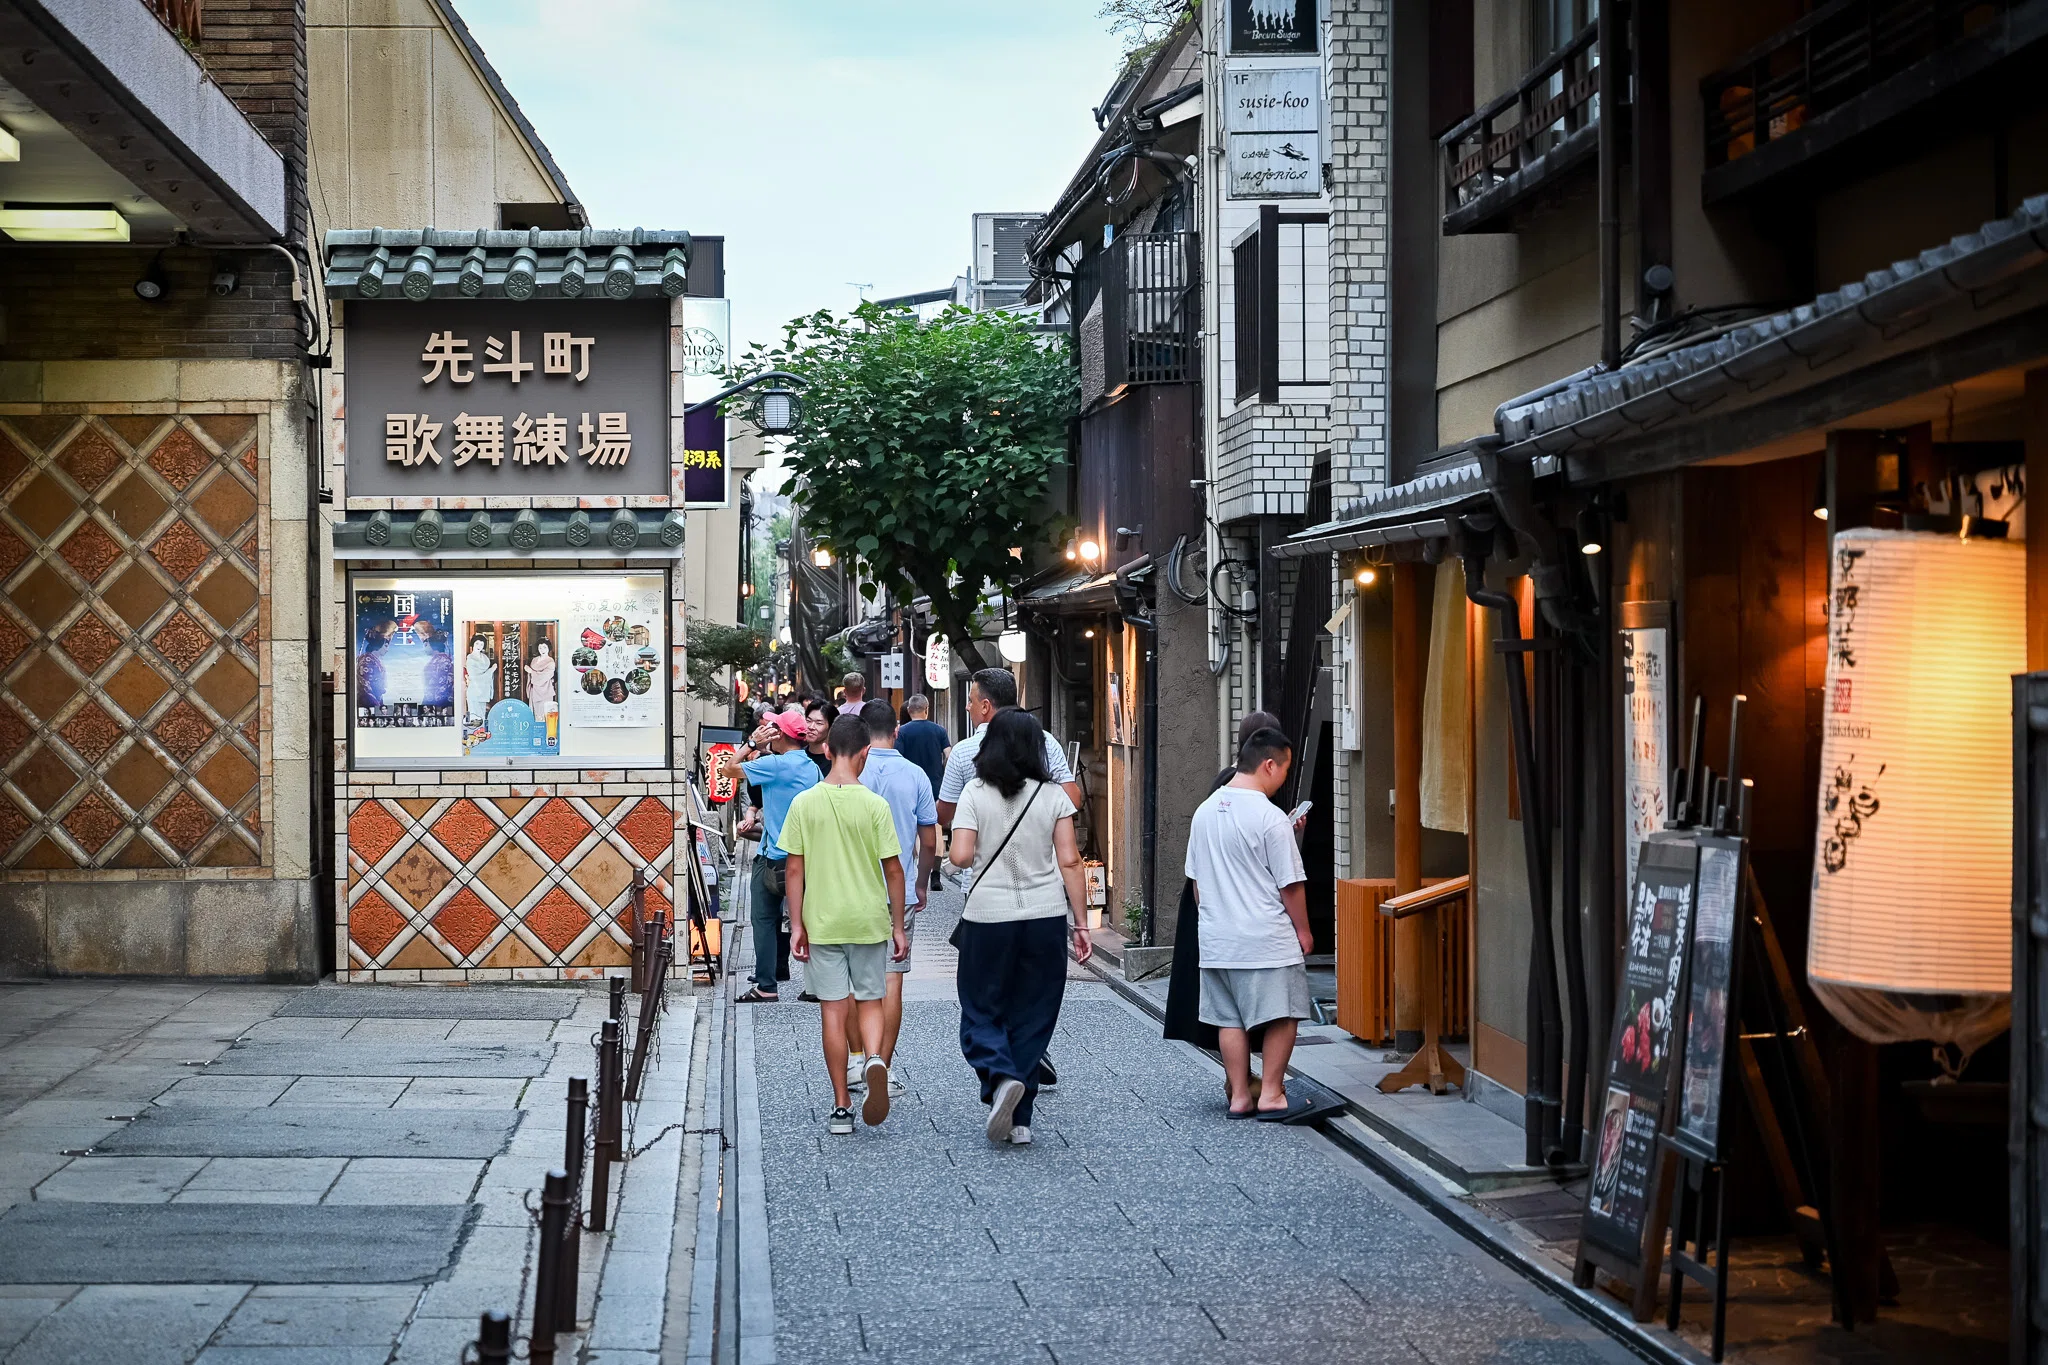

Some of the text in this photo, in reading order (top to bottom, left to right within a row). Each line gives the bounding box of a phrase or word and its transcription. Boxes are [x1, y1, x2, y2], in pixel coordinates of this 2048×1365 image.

[1252, 29, 1276, 40] Brown
[1276, 28, 1301, 43] Sugar
[1232, 74, 1249, 85] 1F
[1238, 90, 1310, 109] susie-koo
[421, 330, 596, 383] 先斗町
[385, 411, 632, 467] 歌舞練場
[393, 593, 416, 647] 国宝
